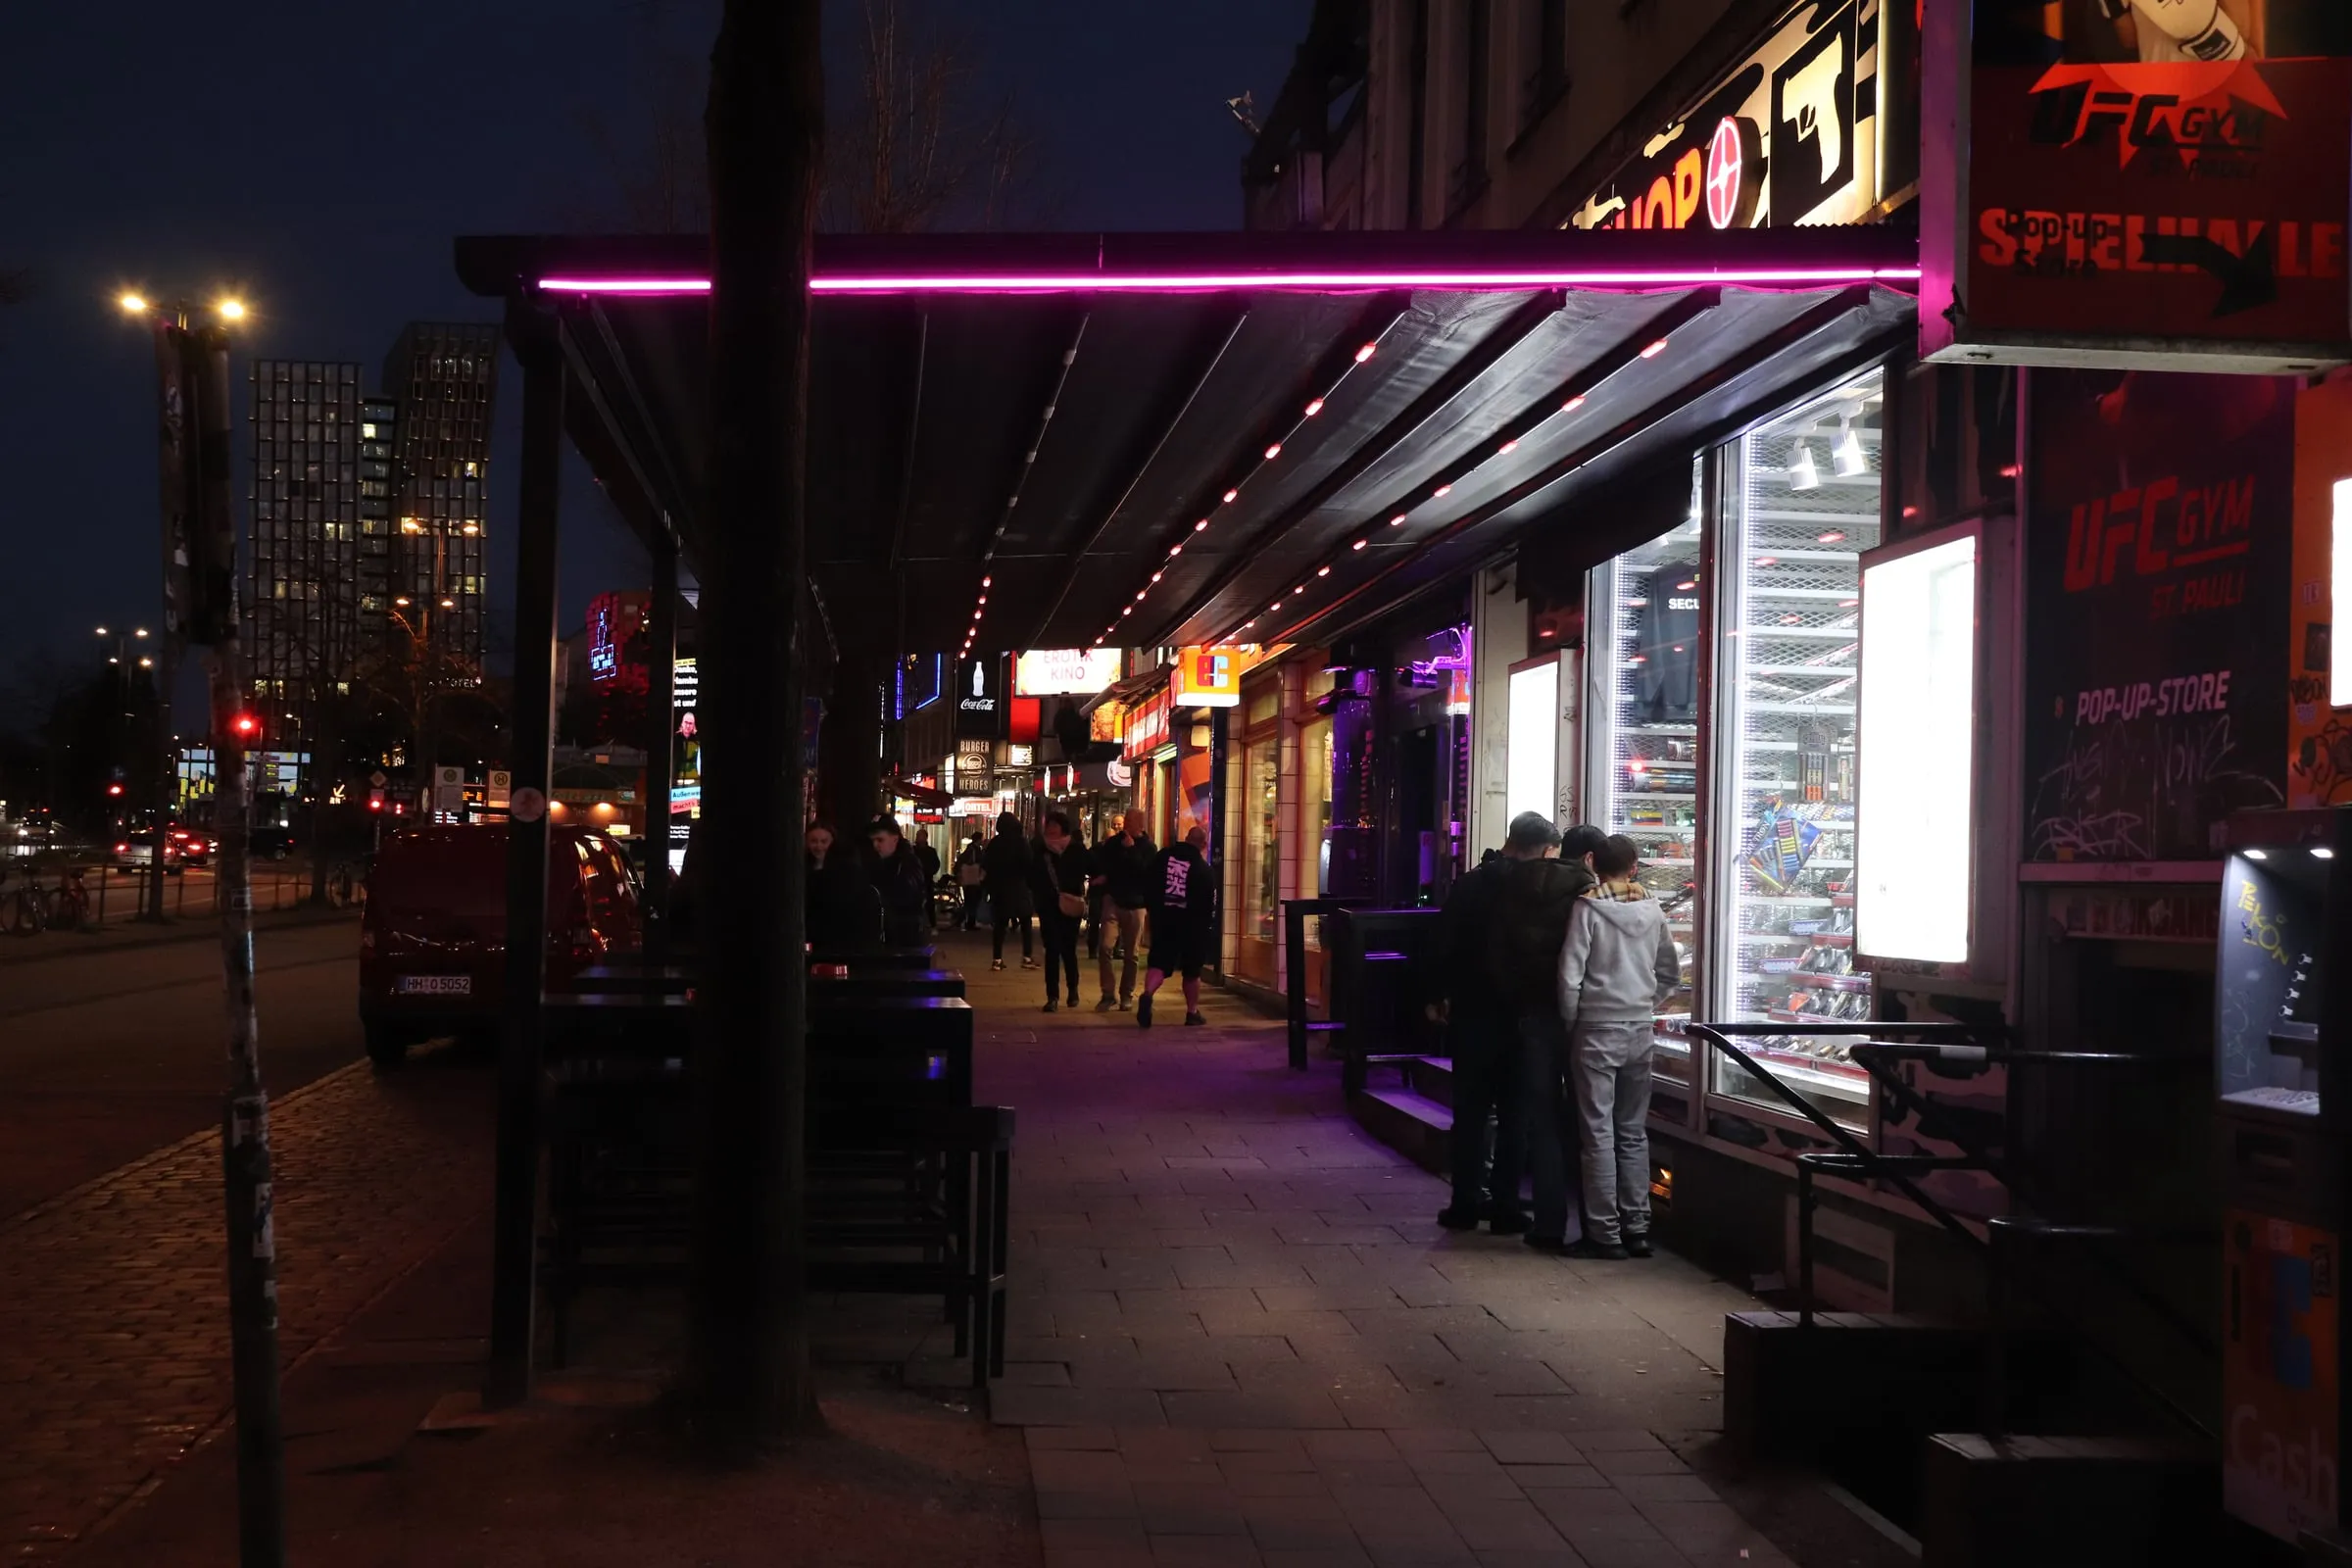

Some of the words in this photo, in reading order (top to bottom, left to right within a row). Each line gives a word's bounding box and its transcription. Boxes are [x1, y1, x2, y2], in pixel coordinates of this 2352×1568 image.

[2029, 80, 2179, 147] UFC
[2180, 107, 2266, 145] GYM
[1602, 148, 1701, 228] OP
[1979, 207, 2343, 278] SPIELHLE
[2063, 475, 2179, 593] UFC
[2176, 474, 2255, 547] GYM
[2182, 566, 2248, 613] PAULI
[1051, 666, 1085, 680] KINO
[2076, 670, 2232, 726] POP-UP-STORE
[960, 740, 990, 753] BURGER
[959, 778, 989, 790] HEROES
[407, 978, 422, 989] HH
[439, 978, 469, 990] 5052
[2230, 1403, 2336, 1518] Cash
